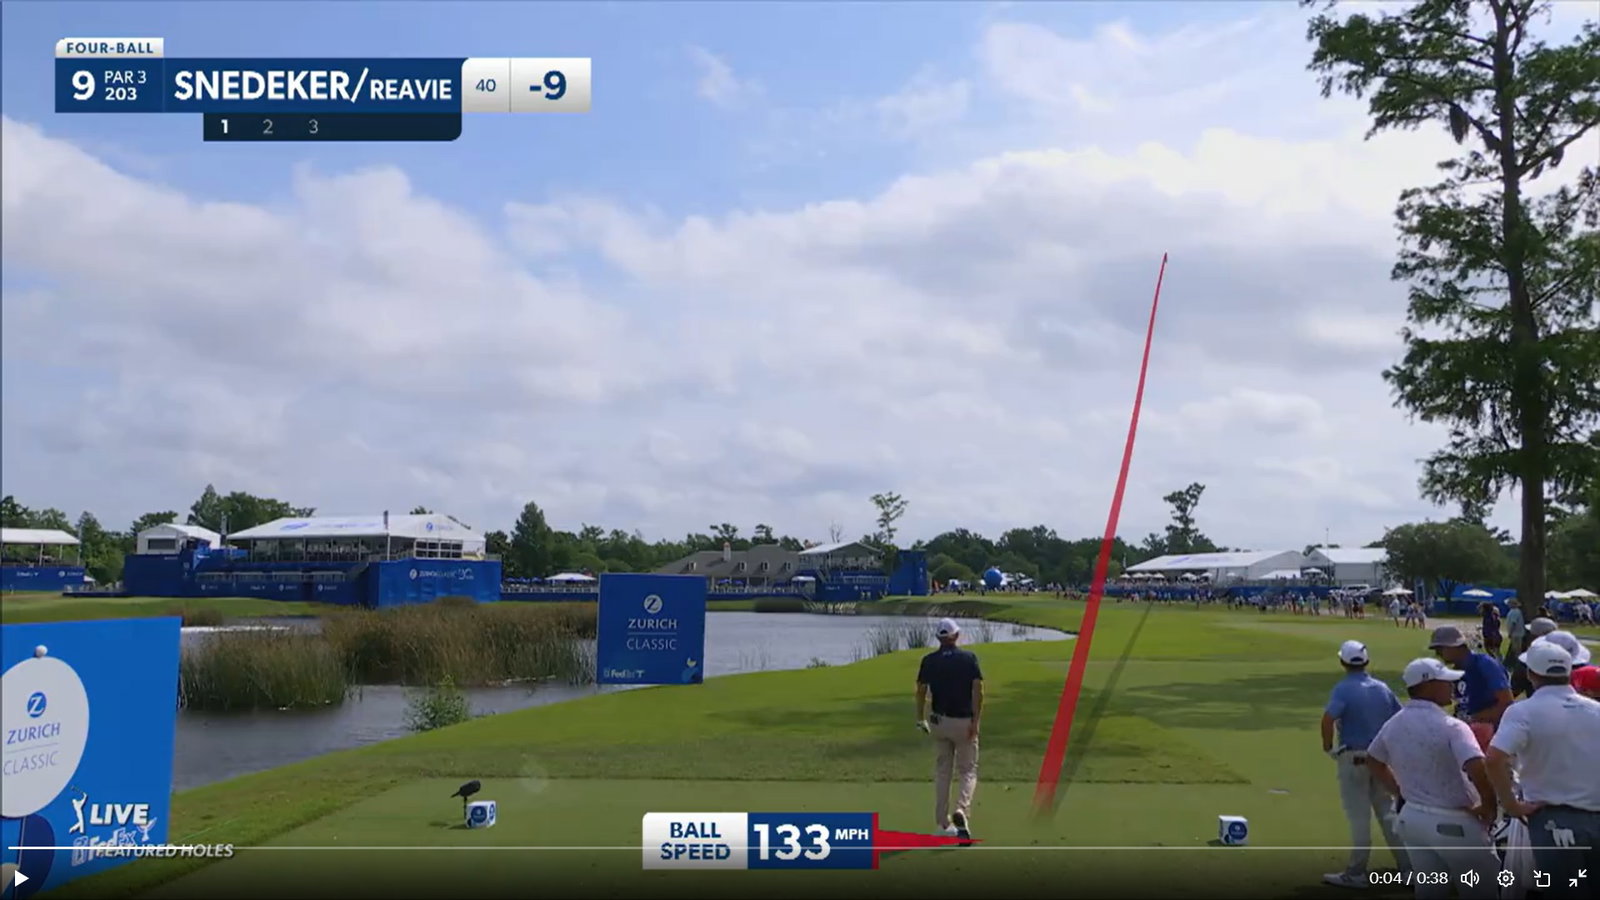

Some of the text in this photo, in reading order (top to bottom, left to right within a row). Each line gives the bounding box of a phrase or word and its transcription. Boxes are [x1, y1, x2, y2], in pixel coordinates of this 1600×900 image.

[628, 618, 678, 630] ZURICH
[626, 638, 678, 651] CLASSIC
[6, 722, 61, 745] ZURICH
[3, 750, 60, 776] CLASSIC
